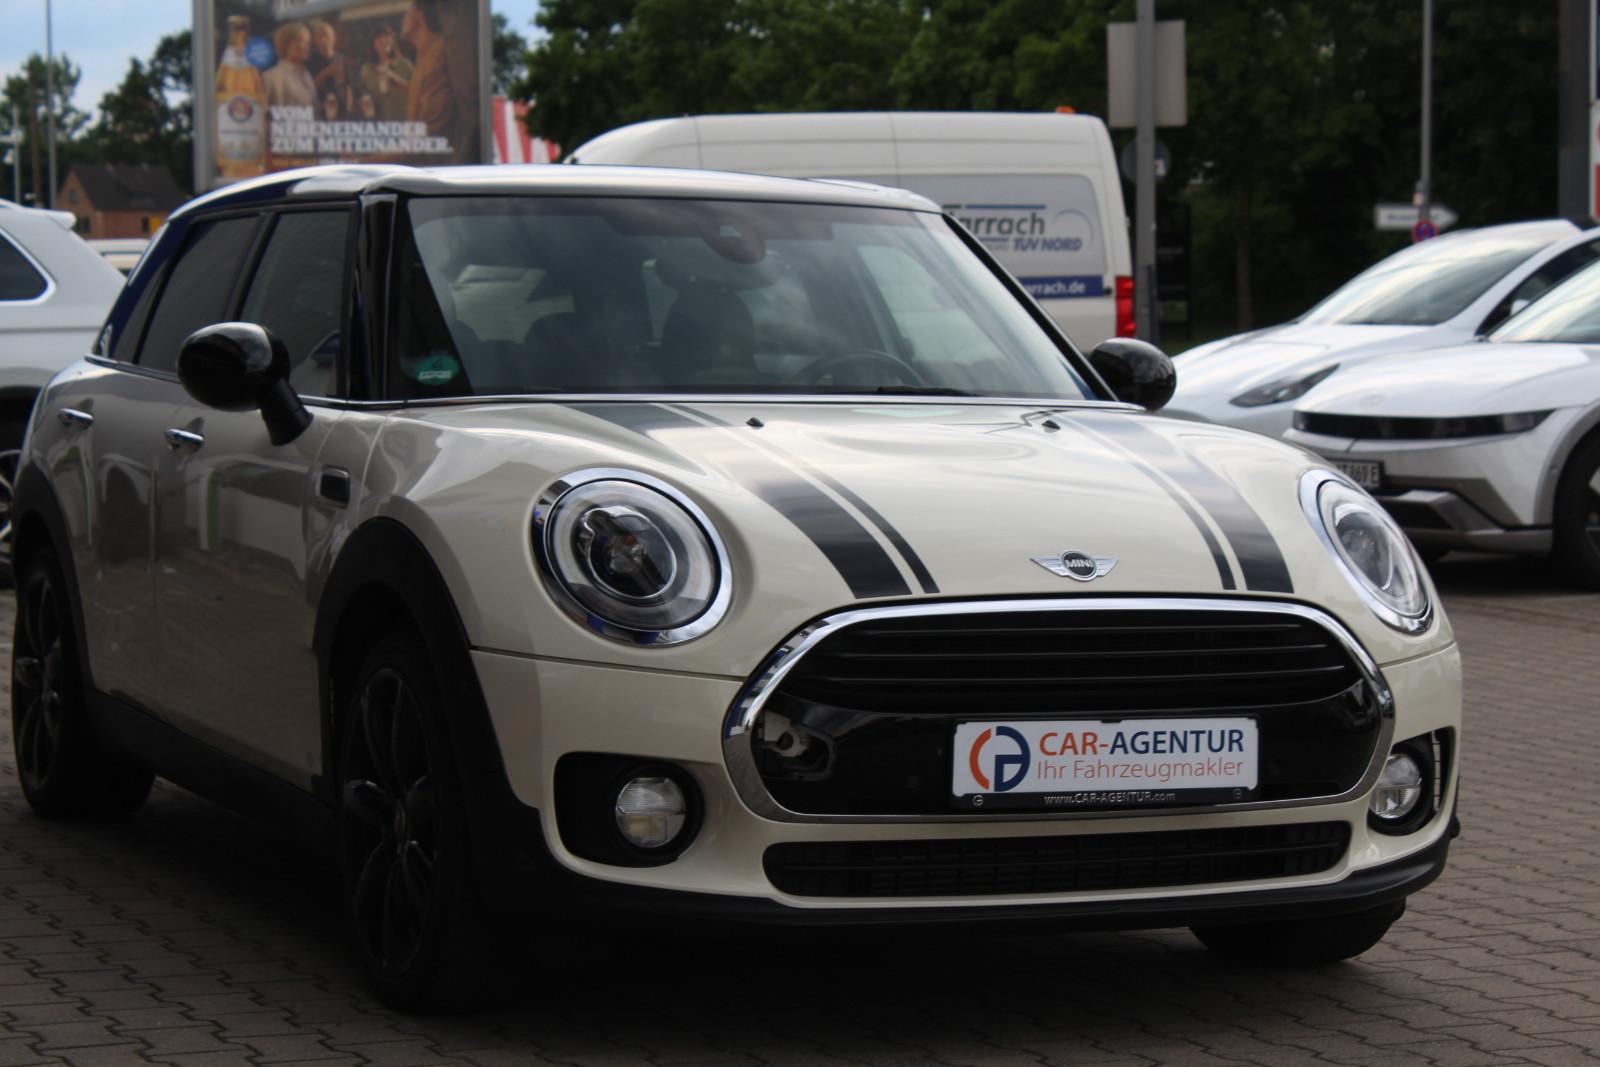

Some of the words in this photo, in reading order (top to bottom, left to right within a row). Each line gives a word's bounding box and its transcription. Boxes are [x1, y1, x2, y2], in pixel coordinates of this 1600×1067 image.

[270, 106, 314, 121] VOM
[271, 121, 427, 136] NEBENEINANDER
[271, 137, 314, 153] ZUM
[949, 211, 1045, 235] arrach
[1064, 559, 1094, 568] MINI
[1039, 729, 1244, 756] CAR-AGENTUR
[1037, 761, 1067, 780] Ihr
[1073, 757, 1245, 782] Fahrzeugmakler
[1044, 791, 1176, 804] www.CAR-AGENTUR.com
